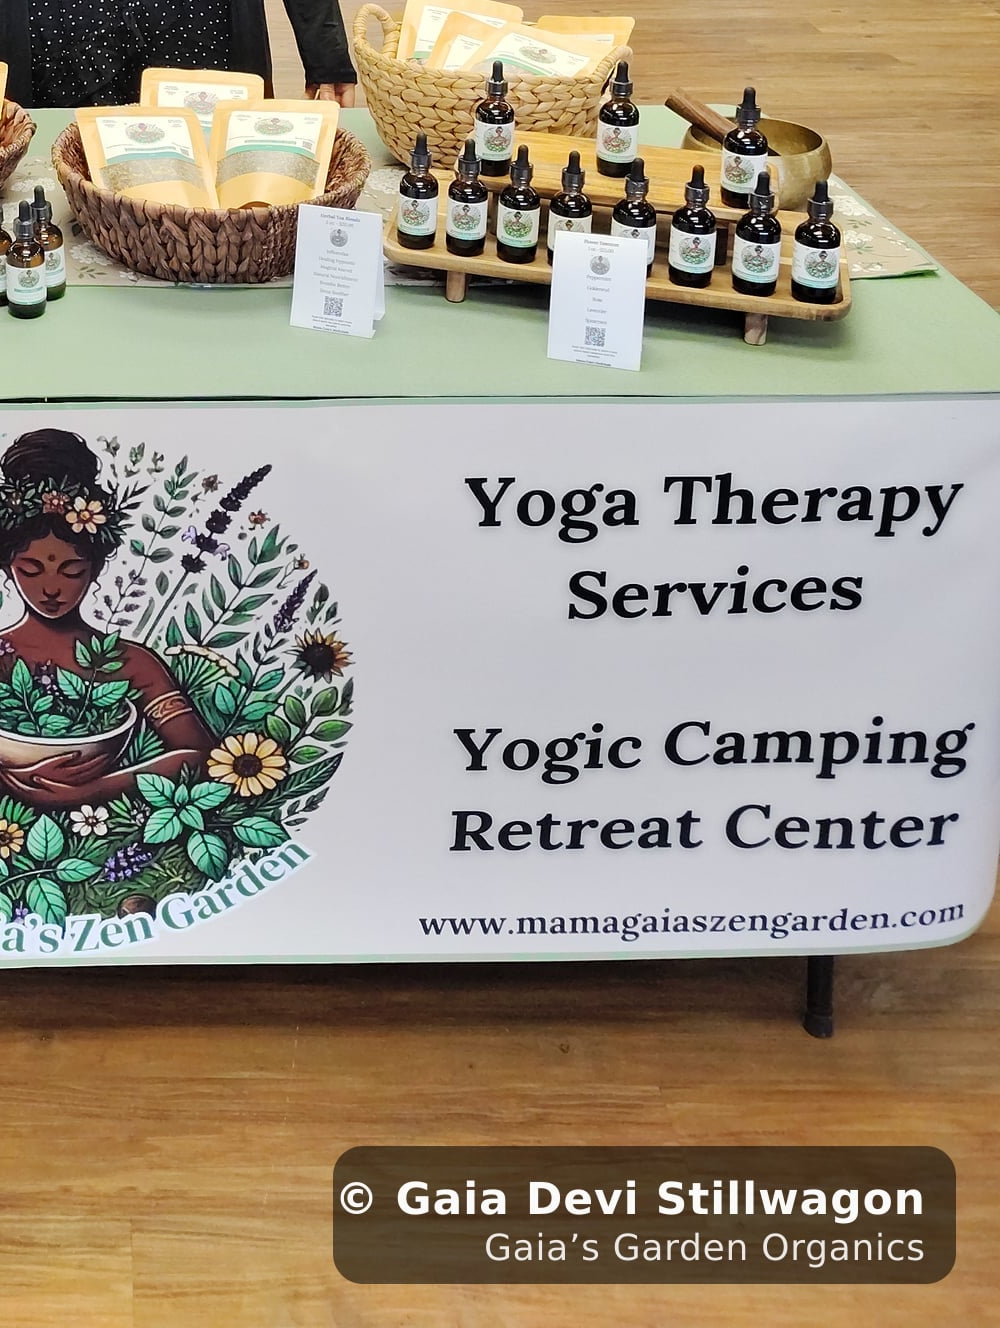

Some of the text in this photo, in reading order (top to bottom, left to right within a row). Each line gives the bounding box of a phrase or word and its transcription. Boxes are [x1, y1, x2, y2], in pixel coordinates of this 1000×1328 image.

[465, 472, 965, 544] Yoga Therapy
[568, 565, 863, 620] Services
[453, 715, 976, 784] Yogic Camping
[449, 804, 960, 852] Retreat Center
[70, 917, 153, 953] Zen
[161, 842, 312, 930] Garden
[419, 903, 965, 943] www.mamagaiaszengarden.com
